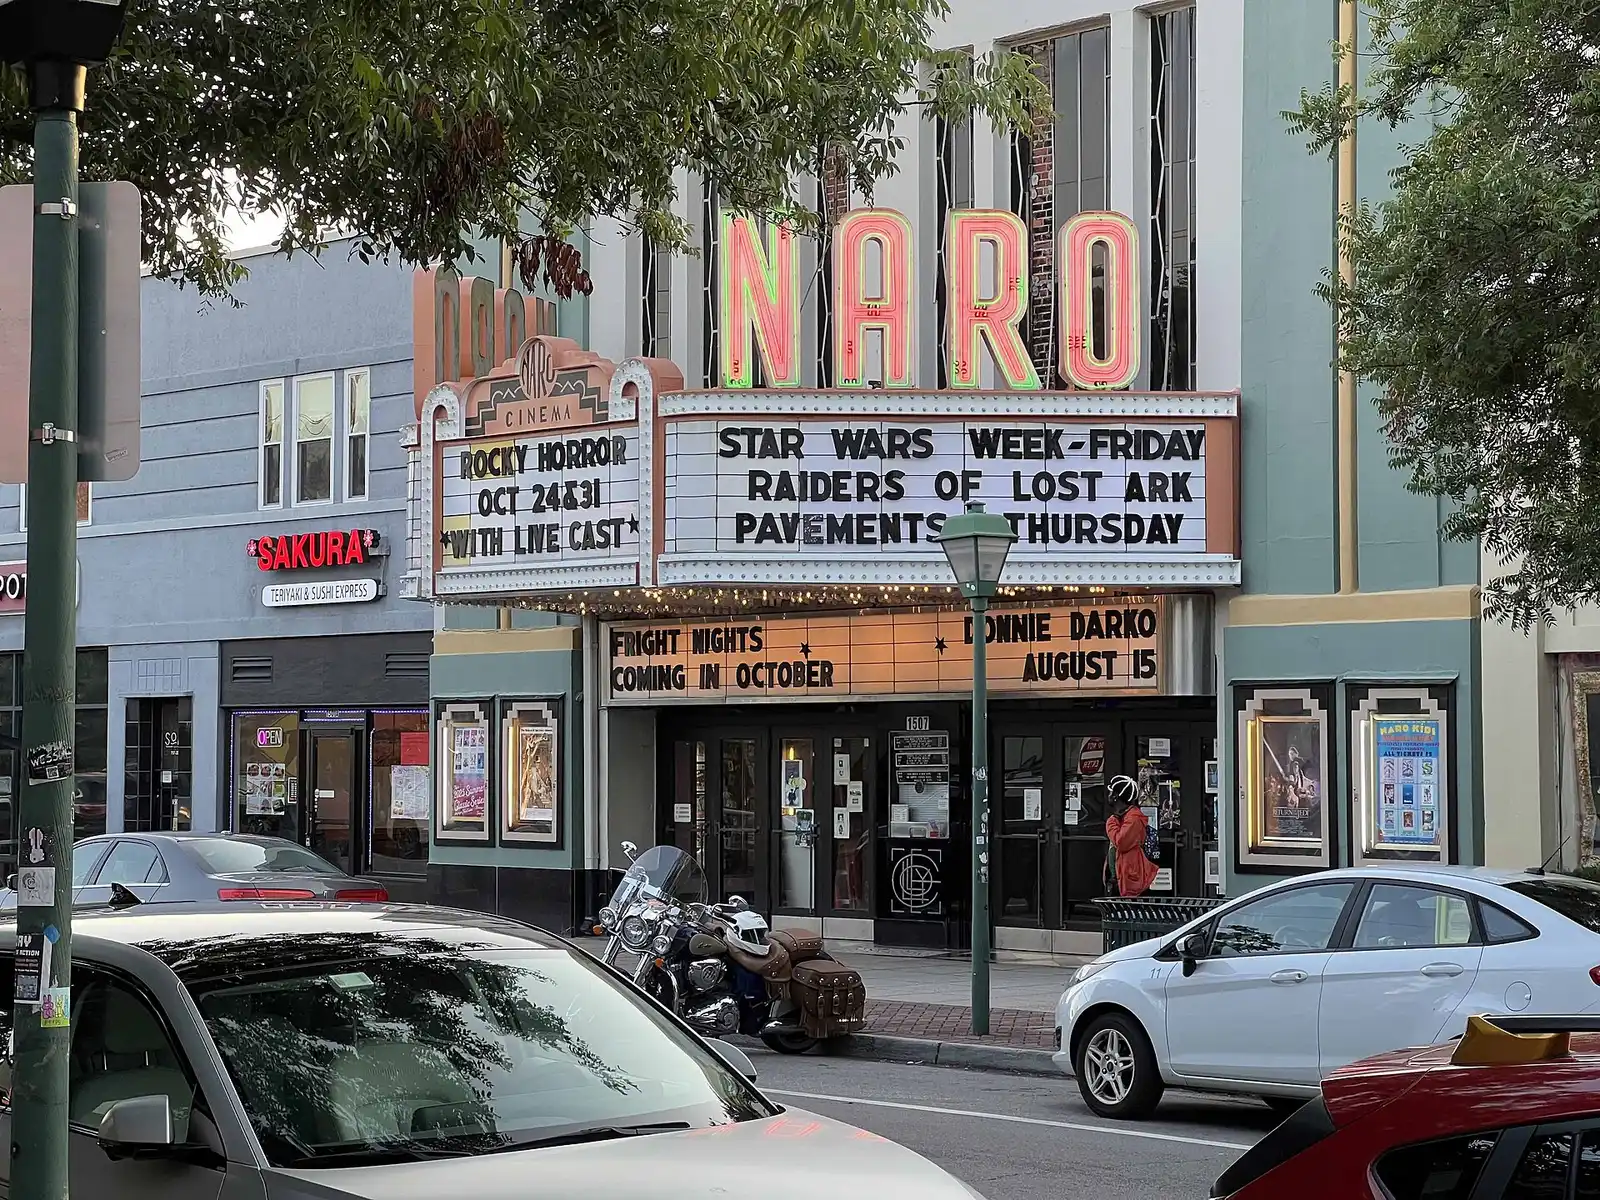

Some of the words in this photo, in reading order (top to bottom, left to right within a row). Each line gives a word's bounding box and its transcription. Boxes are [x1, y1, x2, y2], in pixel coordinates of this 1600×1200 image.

[718, 207, 1140, 390] NARO
[521, 340, 555, 399] NARO
[506, 405, 571, 427] CINEMA
[460, 445, 528, 479] ROCKY
[538, 435, 626, 472] HORROR
[718, 428, 805, 459] STAR
[831, 428, 934, 459] WARS
[968, 428, 1206, 461] WEEK-FRIDAY
[478, 486, 519, 517] OCT
[748, 470, 905, 502] RAIDERS
[934, 470, 983, 501] OF
[1012, 471, 1103, 502] LOST
[1125, 471, 1193, 502] ARK
[451, 527, 503, 559] WITH
[515, 524, 560, 555] LIVE
[569, 518, 625, 551] CAST
[736, 513, 946, 544] PAVEMENTS
[1004, 513, 1184, 544] THURSDAY
[257, 529, 363, 571] SAKURA
[271, 588, 302, 602] TERIYAKI
[304, 587, 309, 600] &
[311, 585, 334, 600] SUSHI
[335, 583, 368, 599] EXPRESS
[613, 630, 680, 657] FRIGHT
[692, 626, 763, 654] NIGHTS
[1070, 609, 1156, 640] DARKO
[612, 664, 685, 692] COMING
[700, 663, 720, 690] IN
[736, 660, 834, 688] OCTOBER
[1023, 650, 1117, 683] AUGUST
[1133, 649, 1156, 679] 15
[258, 731, 281, 745] OPEN
[907, 716, 929, 730] 1507
[1149, 967, 1161, 979] 11
